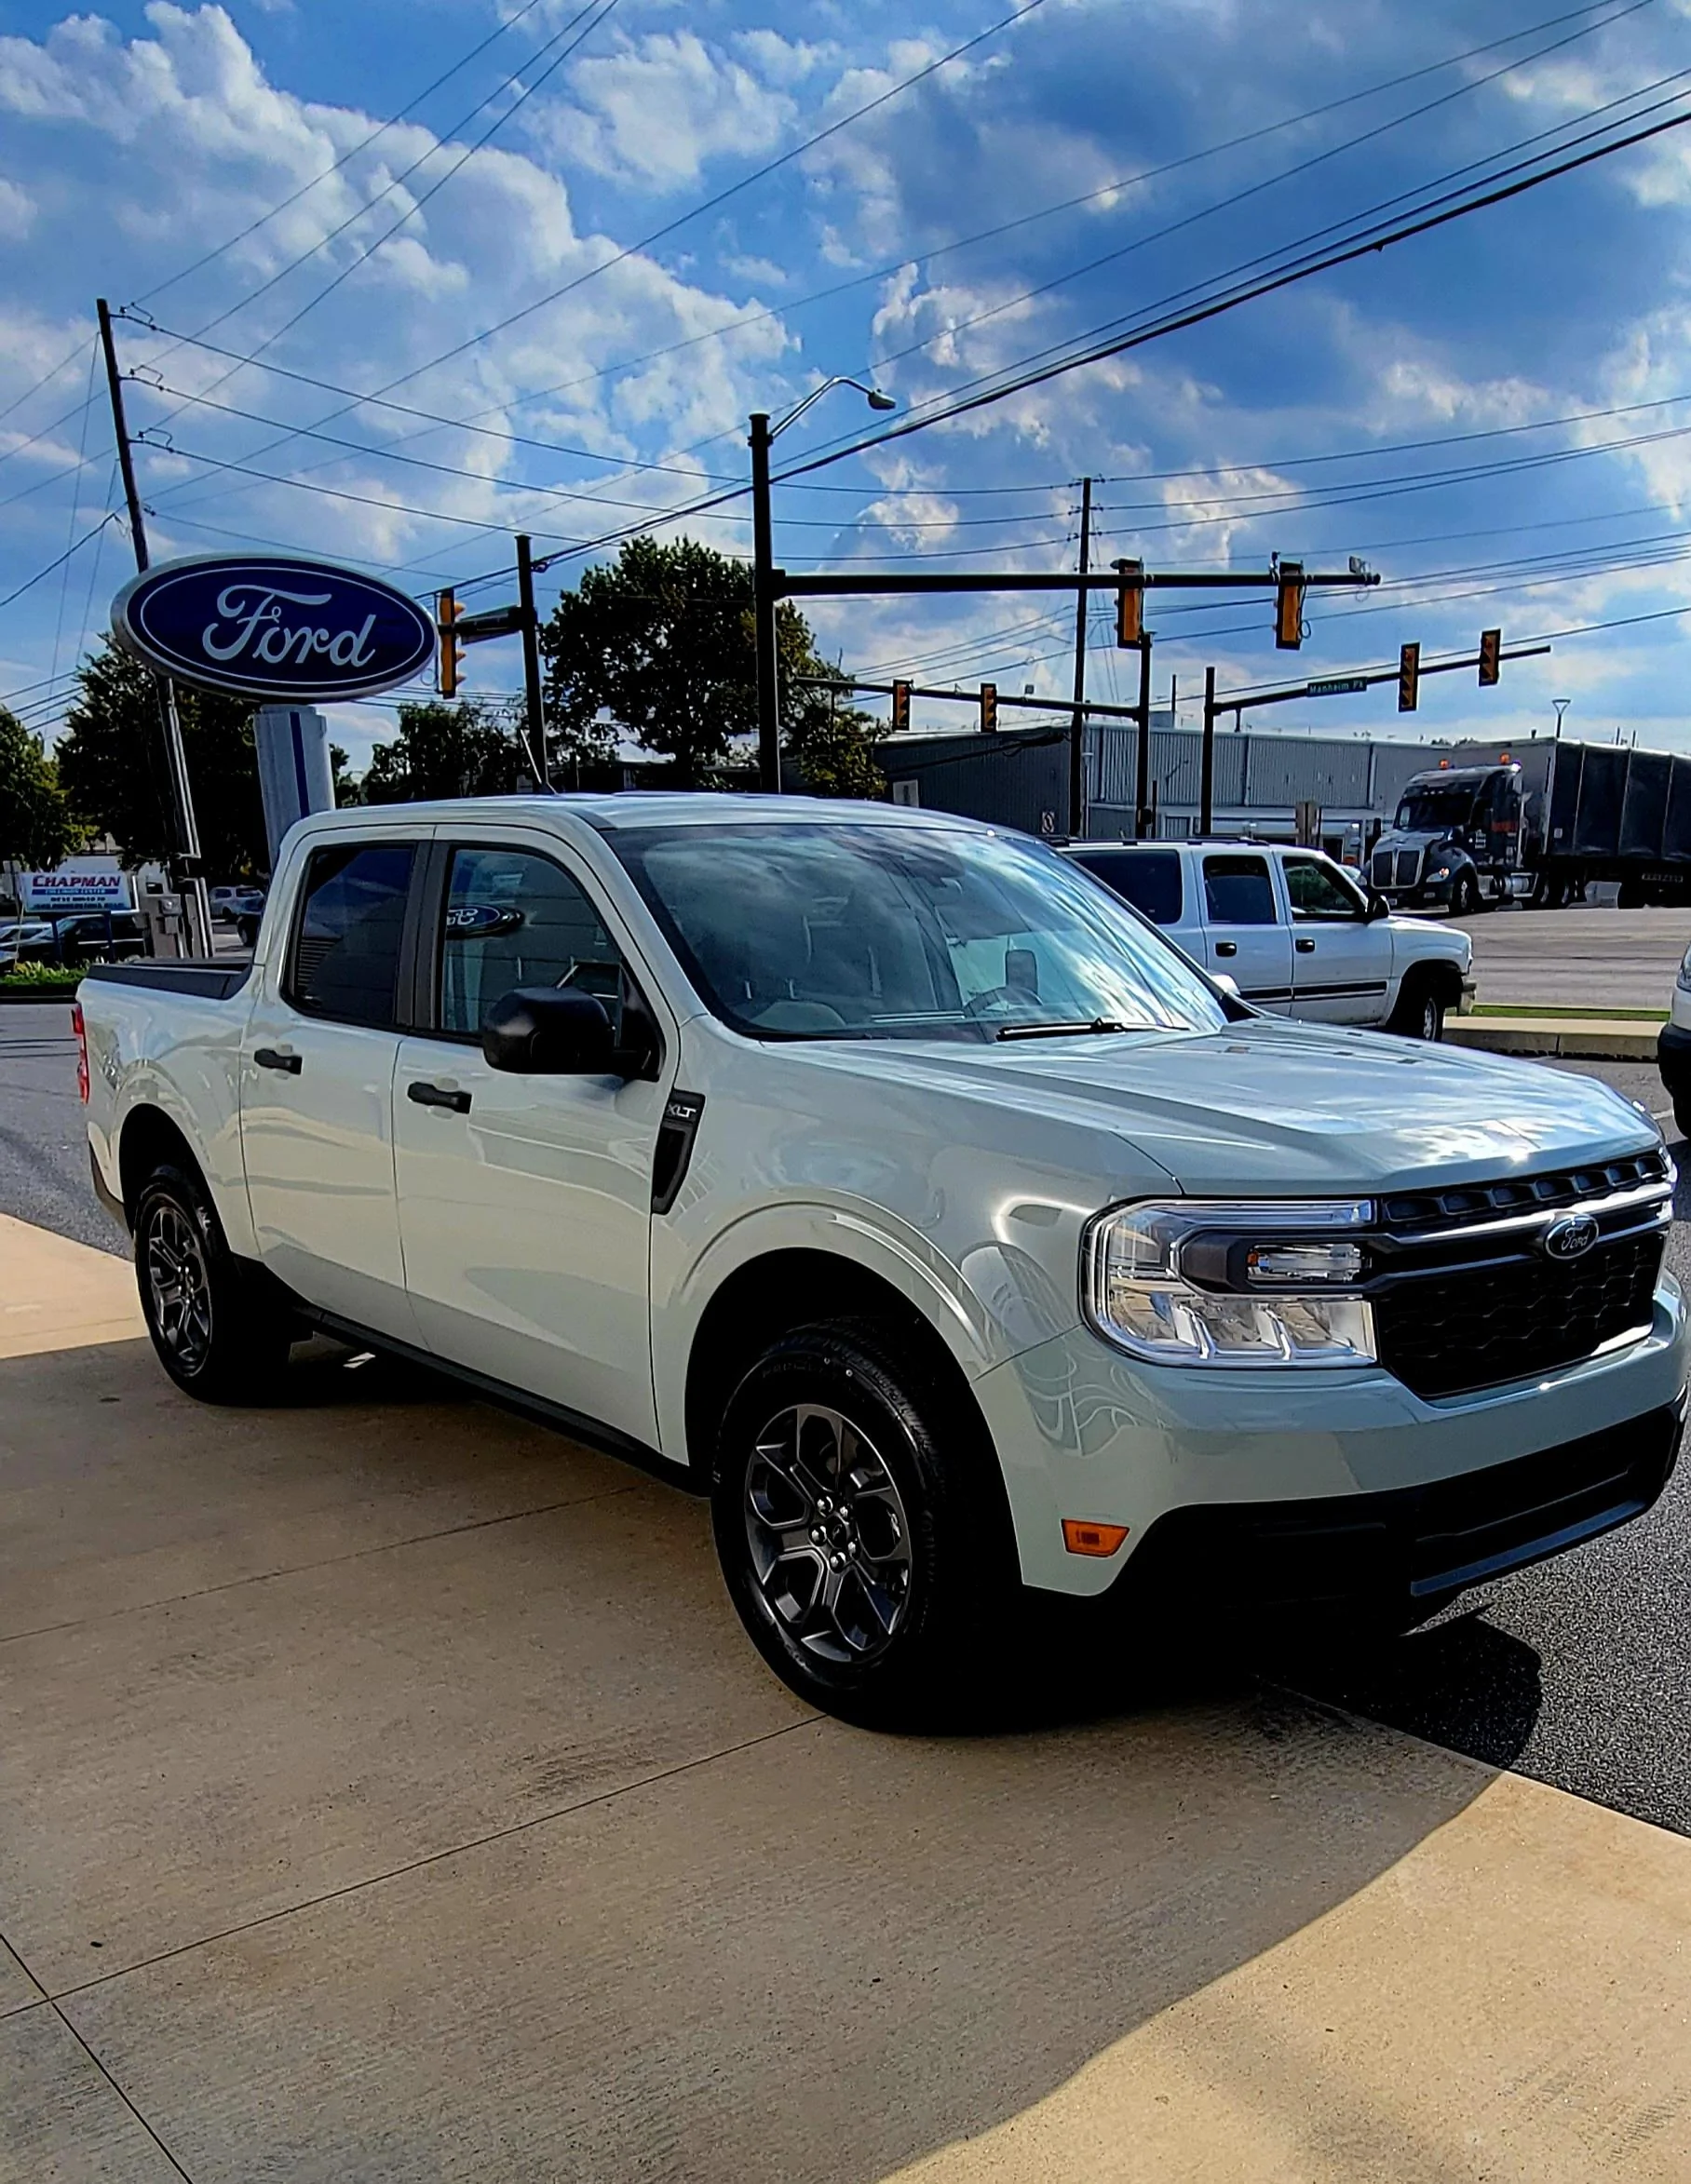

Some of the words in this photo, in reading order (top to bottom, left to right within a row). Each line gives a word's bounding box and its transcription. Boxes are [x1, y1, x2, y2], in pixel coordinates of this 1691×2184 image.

[202, 584, 377, 667] Ford
[32, 875, 121, 887] CHAPMAN
[666, 1102, 697, 1118] XLT
[1561, 1221, 1591, 1251] Ford
